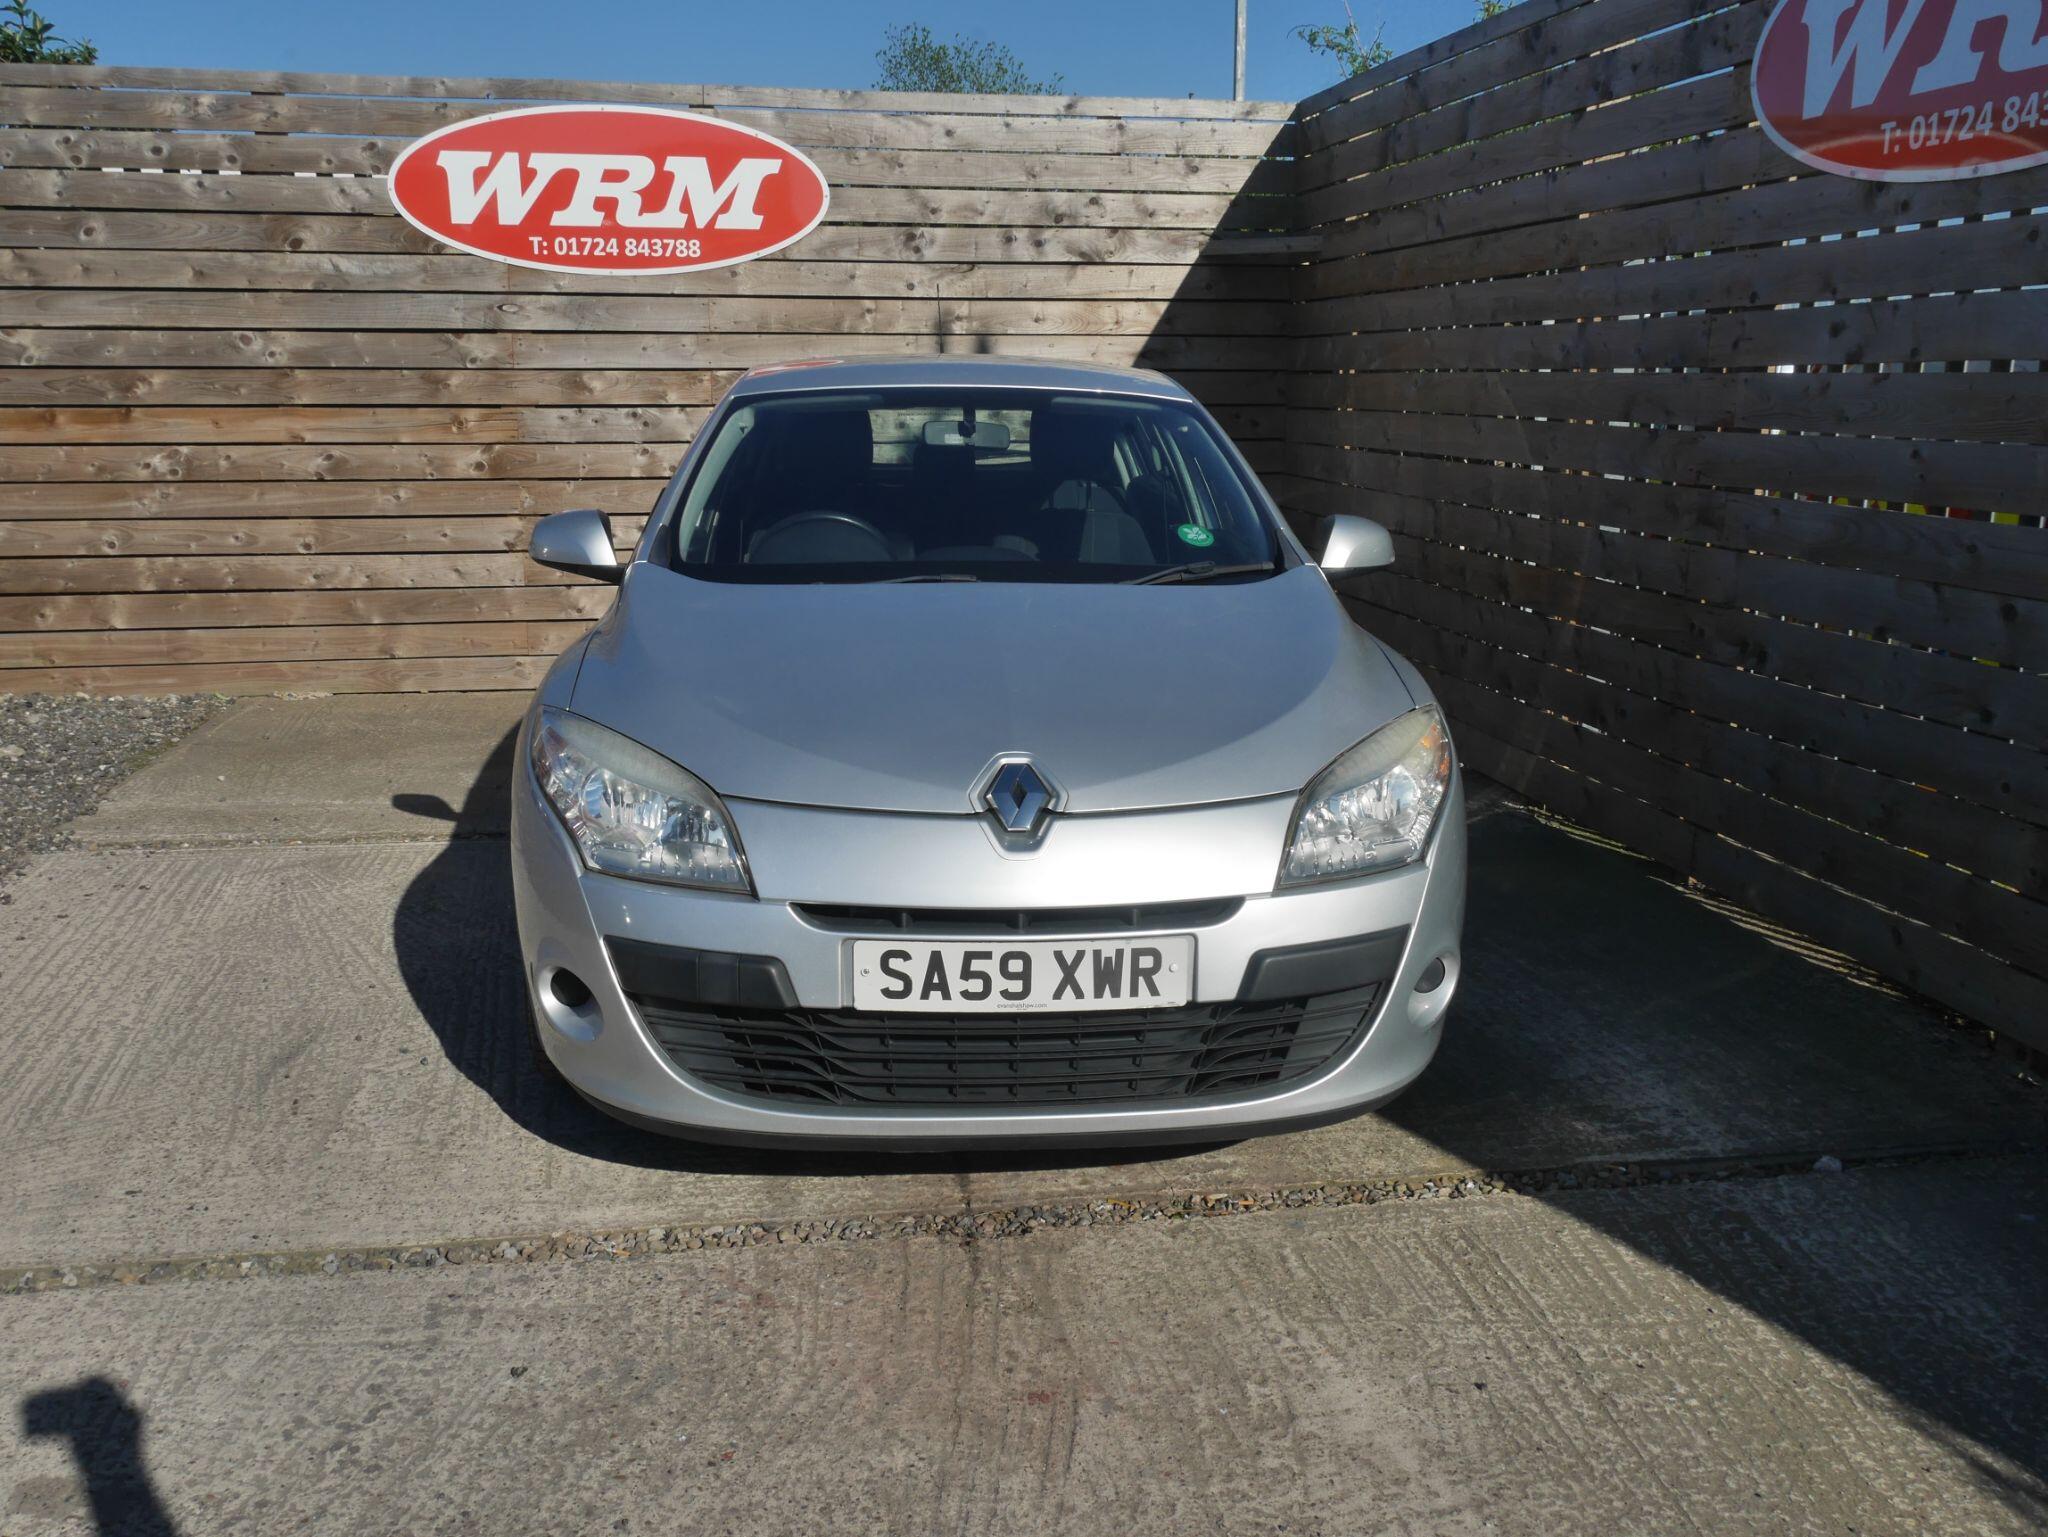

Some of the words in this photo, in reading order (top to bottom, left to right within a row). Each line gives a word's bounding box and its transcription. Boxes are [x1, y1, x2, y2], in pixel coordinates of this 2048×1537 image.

[1801, 0, 2048, 120] WR
[1881, 120, 1902, 154] T:
[1909, 101, 1994, 150] 01724
[436, 150, 782, 230] WRM
[529, 236, 548, 256] T:
[554, 237, 619, 257] 01724
[624, 238, 701, 259] 843788
[880, 949, 1033, 1001] SA59
[1052, 947, 1163, 1001] XWR
